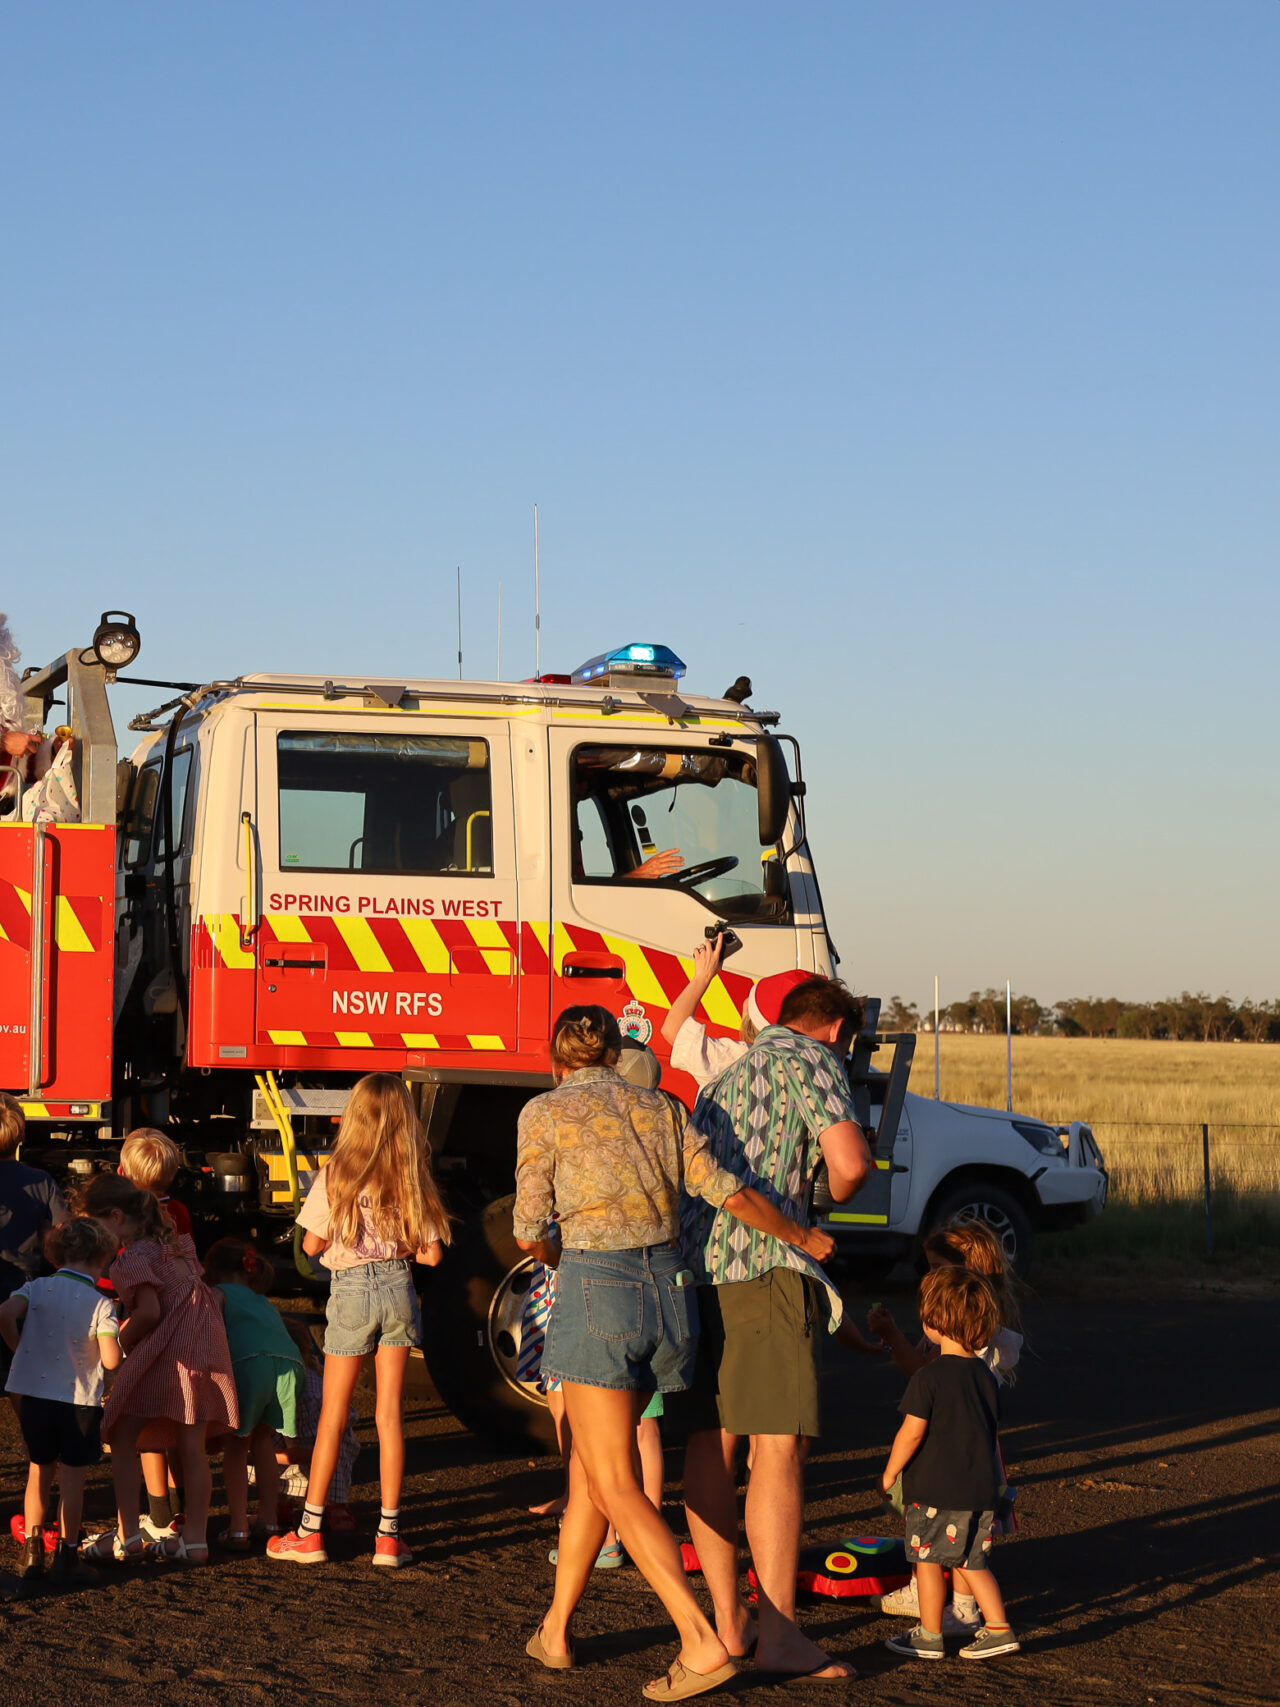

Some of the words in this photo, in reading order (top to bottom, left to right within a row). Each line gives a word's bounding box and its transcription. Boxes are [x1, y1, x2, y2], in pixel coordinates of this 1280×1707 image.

[269, 893, 351, 913] SPRING
[358, 896, 435, 916] PLAINS
[441, 899, 503, 918] WEST
[332, 990, 389, 1015] NSW
[395, 991, 443, 1017] RFS
